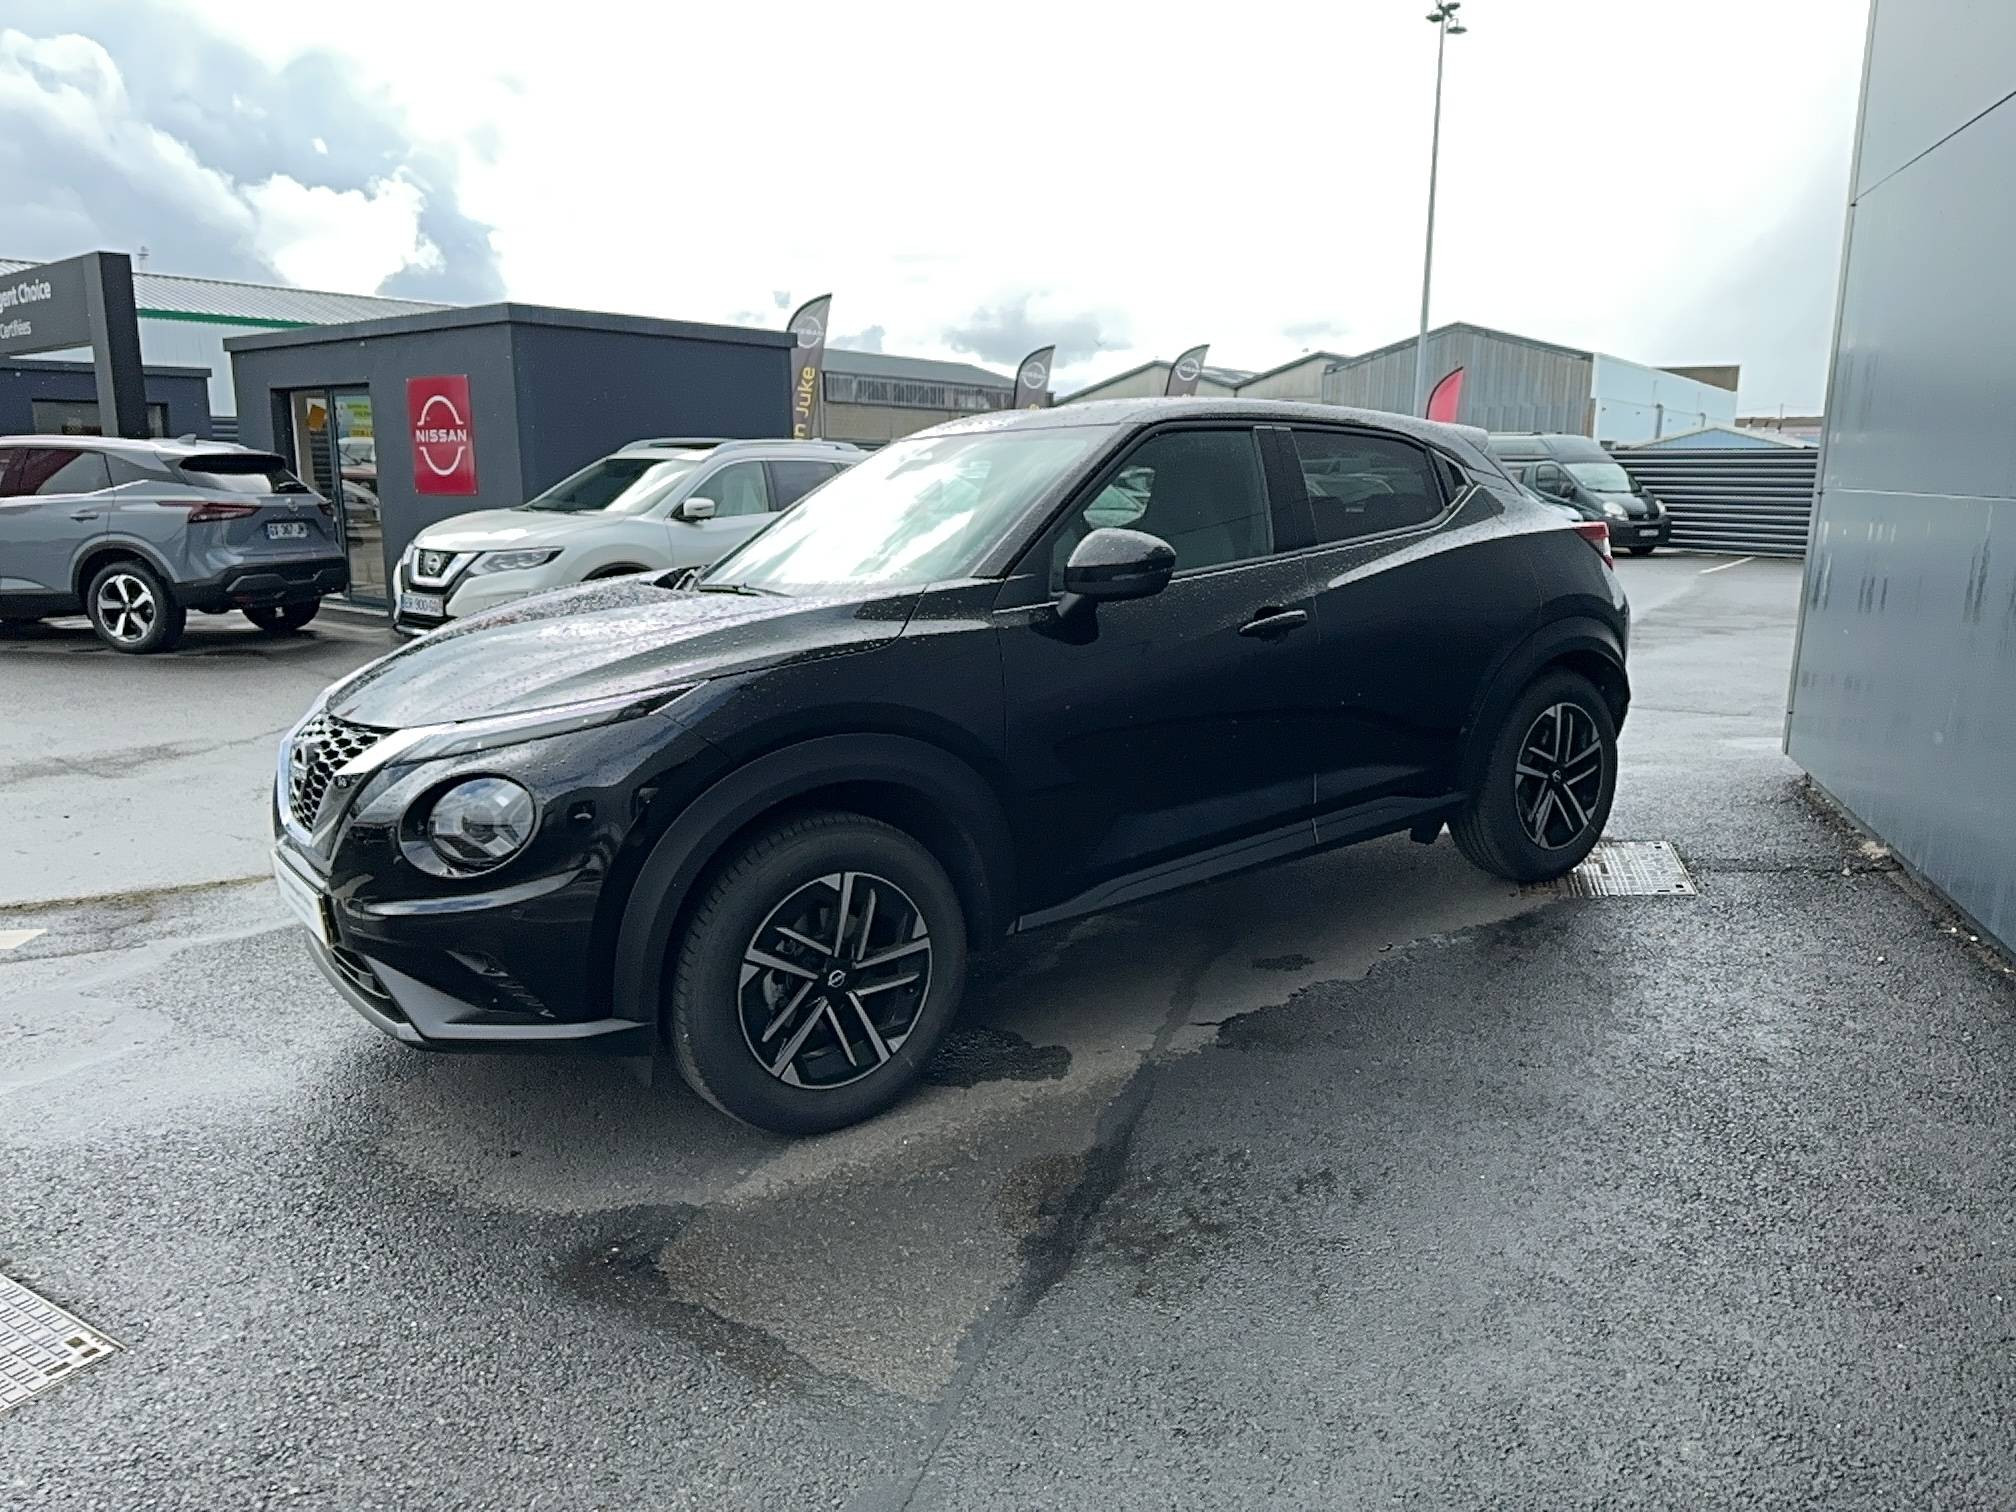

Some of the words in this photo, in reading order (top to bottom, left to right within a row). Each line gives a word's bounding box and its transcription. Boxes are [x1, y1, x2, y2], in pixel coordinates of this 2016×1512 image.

[18, 279, 51, 304] Choice
[795, 366, 816, 418] Juke
[416, 429, 467, 442] NISSAN
